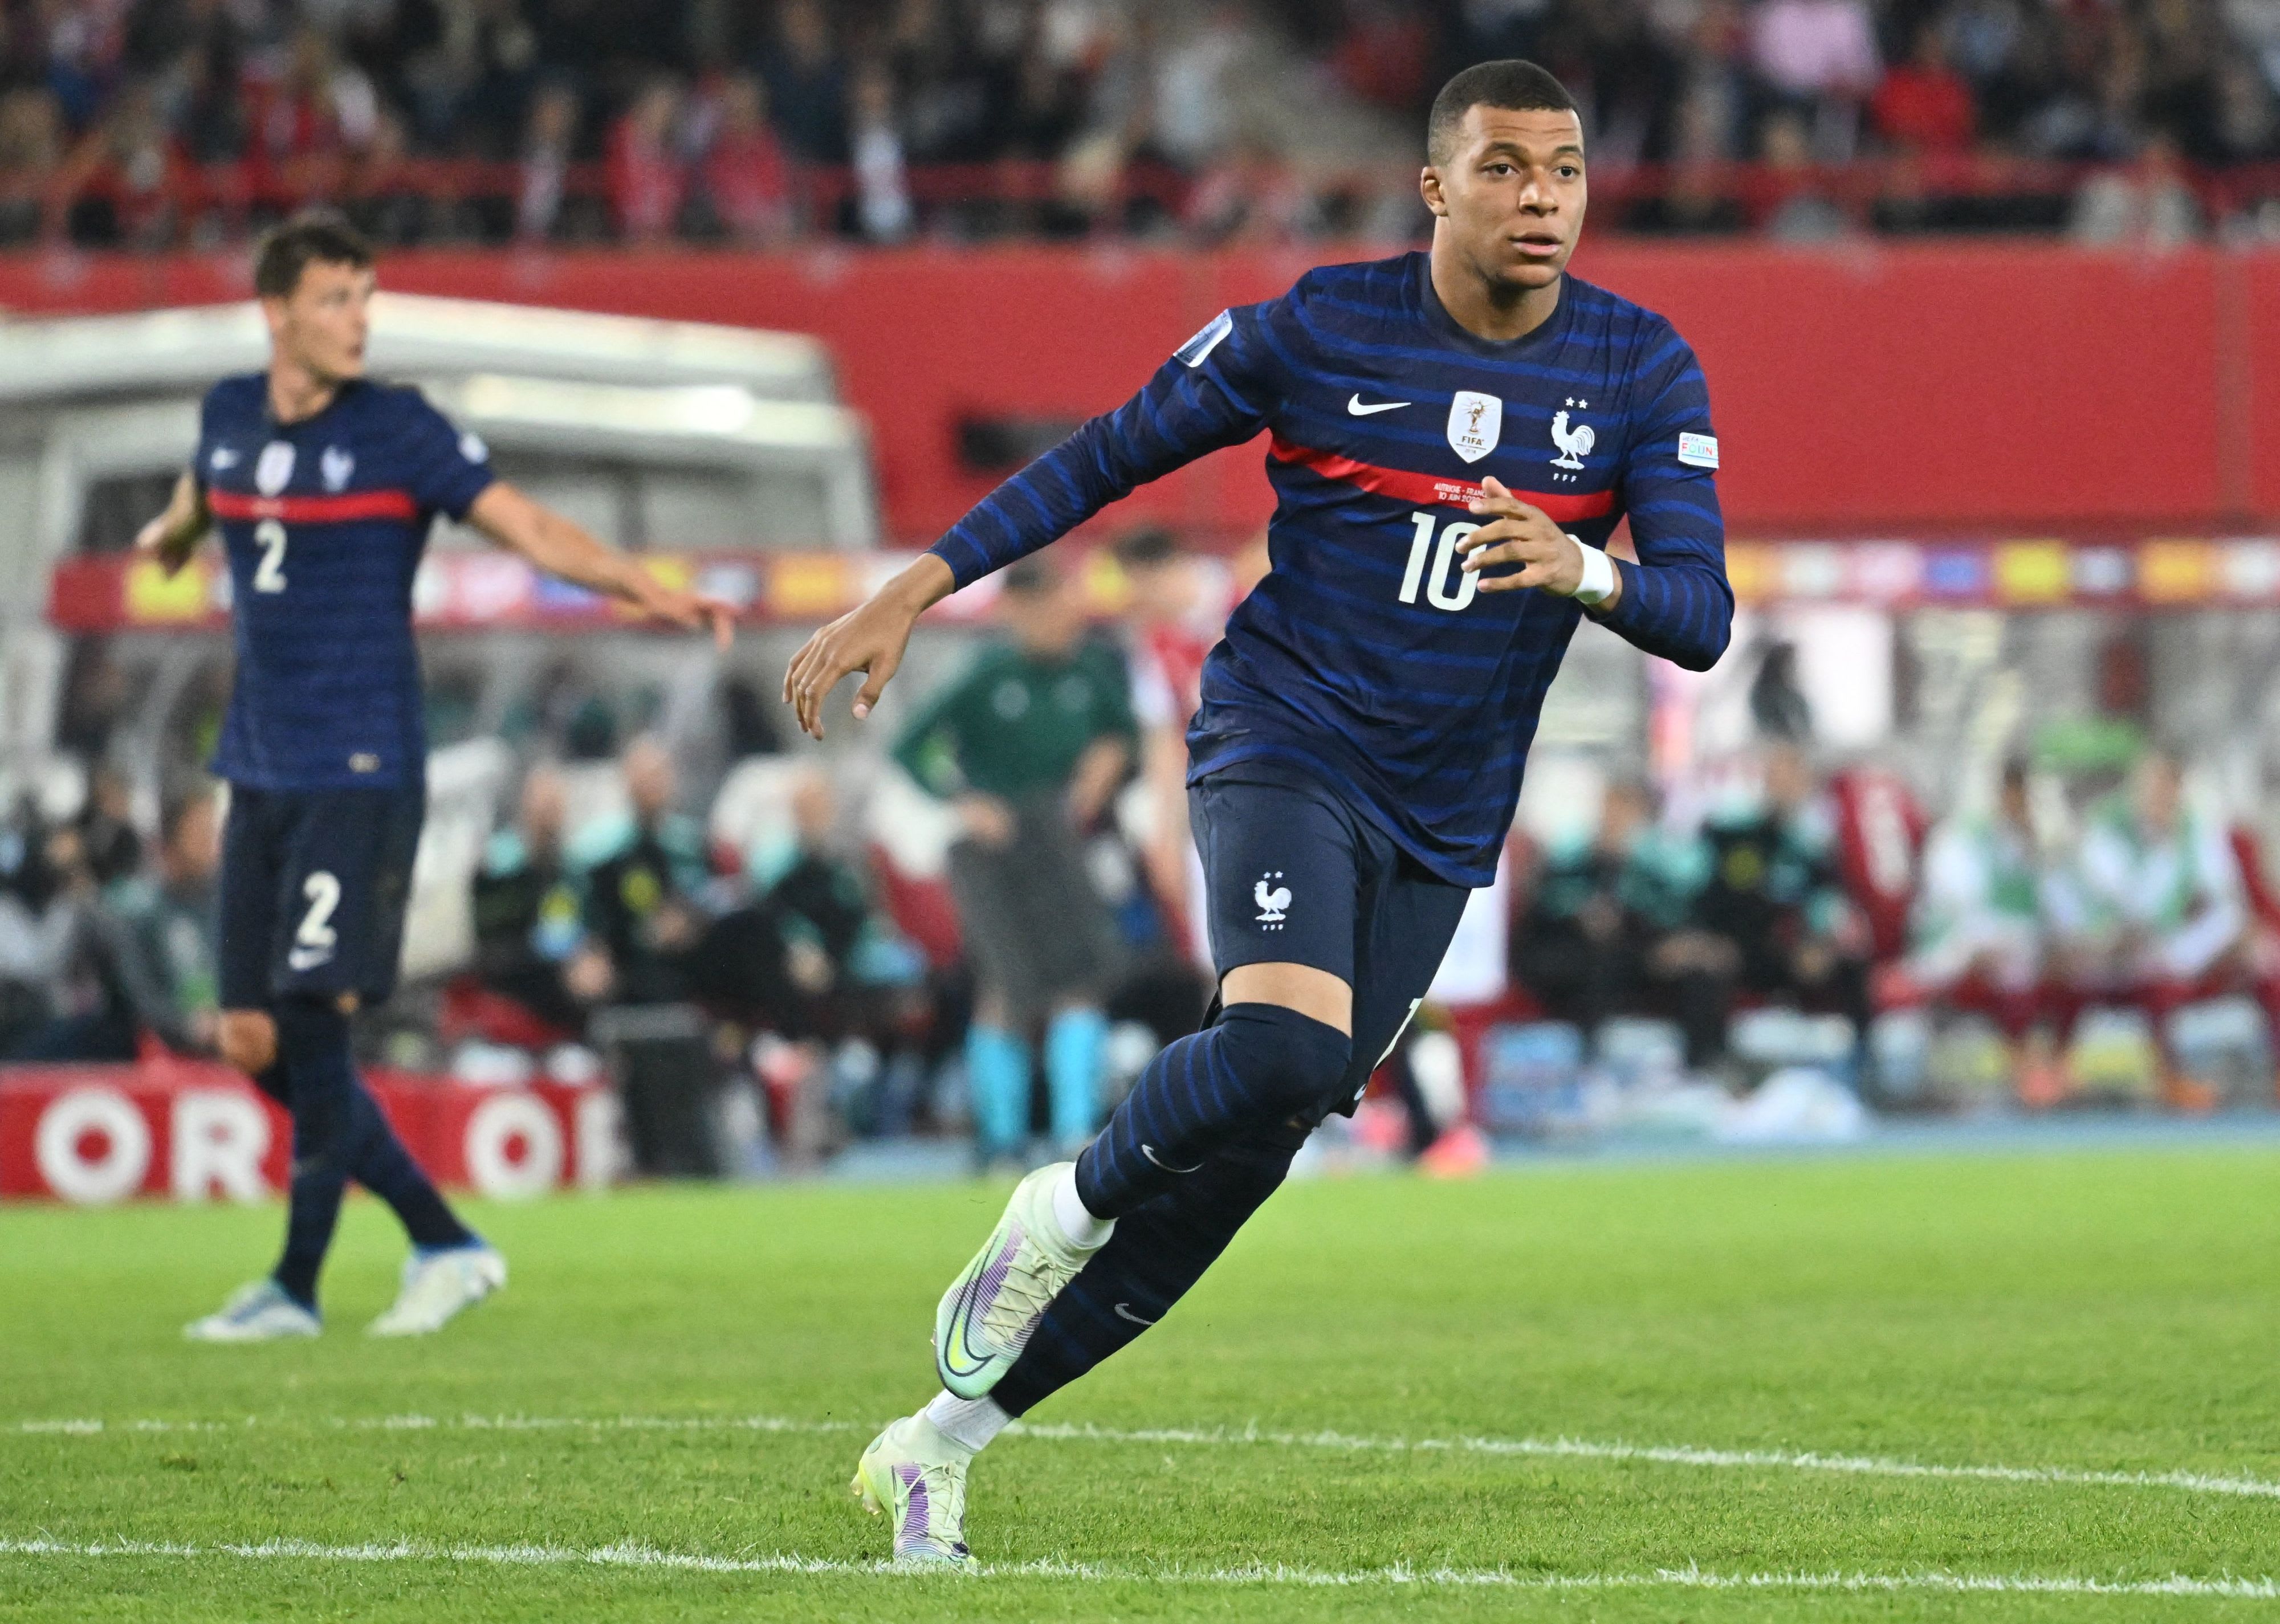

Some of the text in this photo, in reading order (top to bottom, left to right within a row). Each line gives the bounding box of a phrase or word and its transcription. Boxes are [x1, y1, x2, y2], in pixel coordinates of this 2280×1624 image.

[1461, 436, 1482, 446] FIFA
[1439, 491, 1447, 500] 10
[1466, 487, 1487, 497] FRANC
[1553, 473, 1577, 482] FFF
[253, 519, 286, 593] 2
[1399, 512, 1487, 611] 10
[297, 871, 341, 947] 2
[34, 1091, 271, 1202] OR
